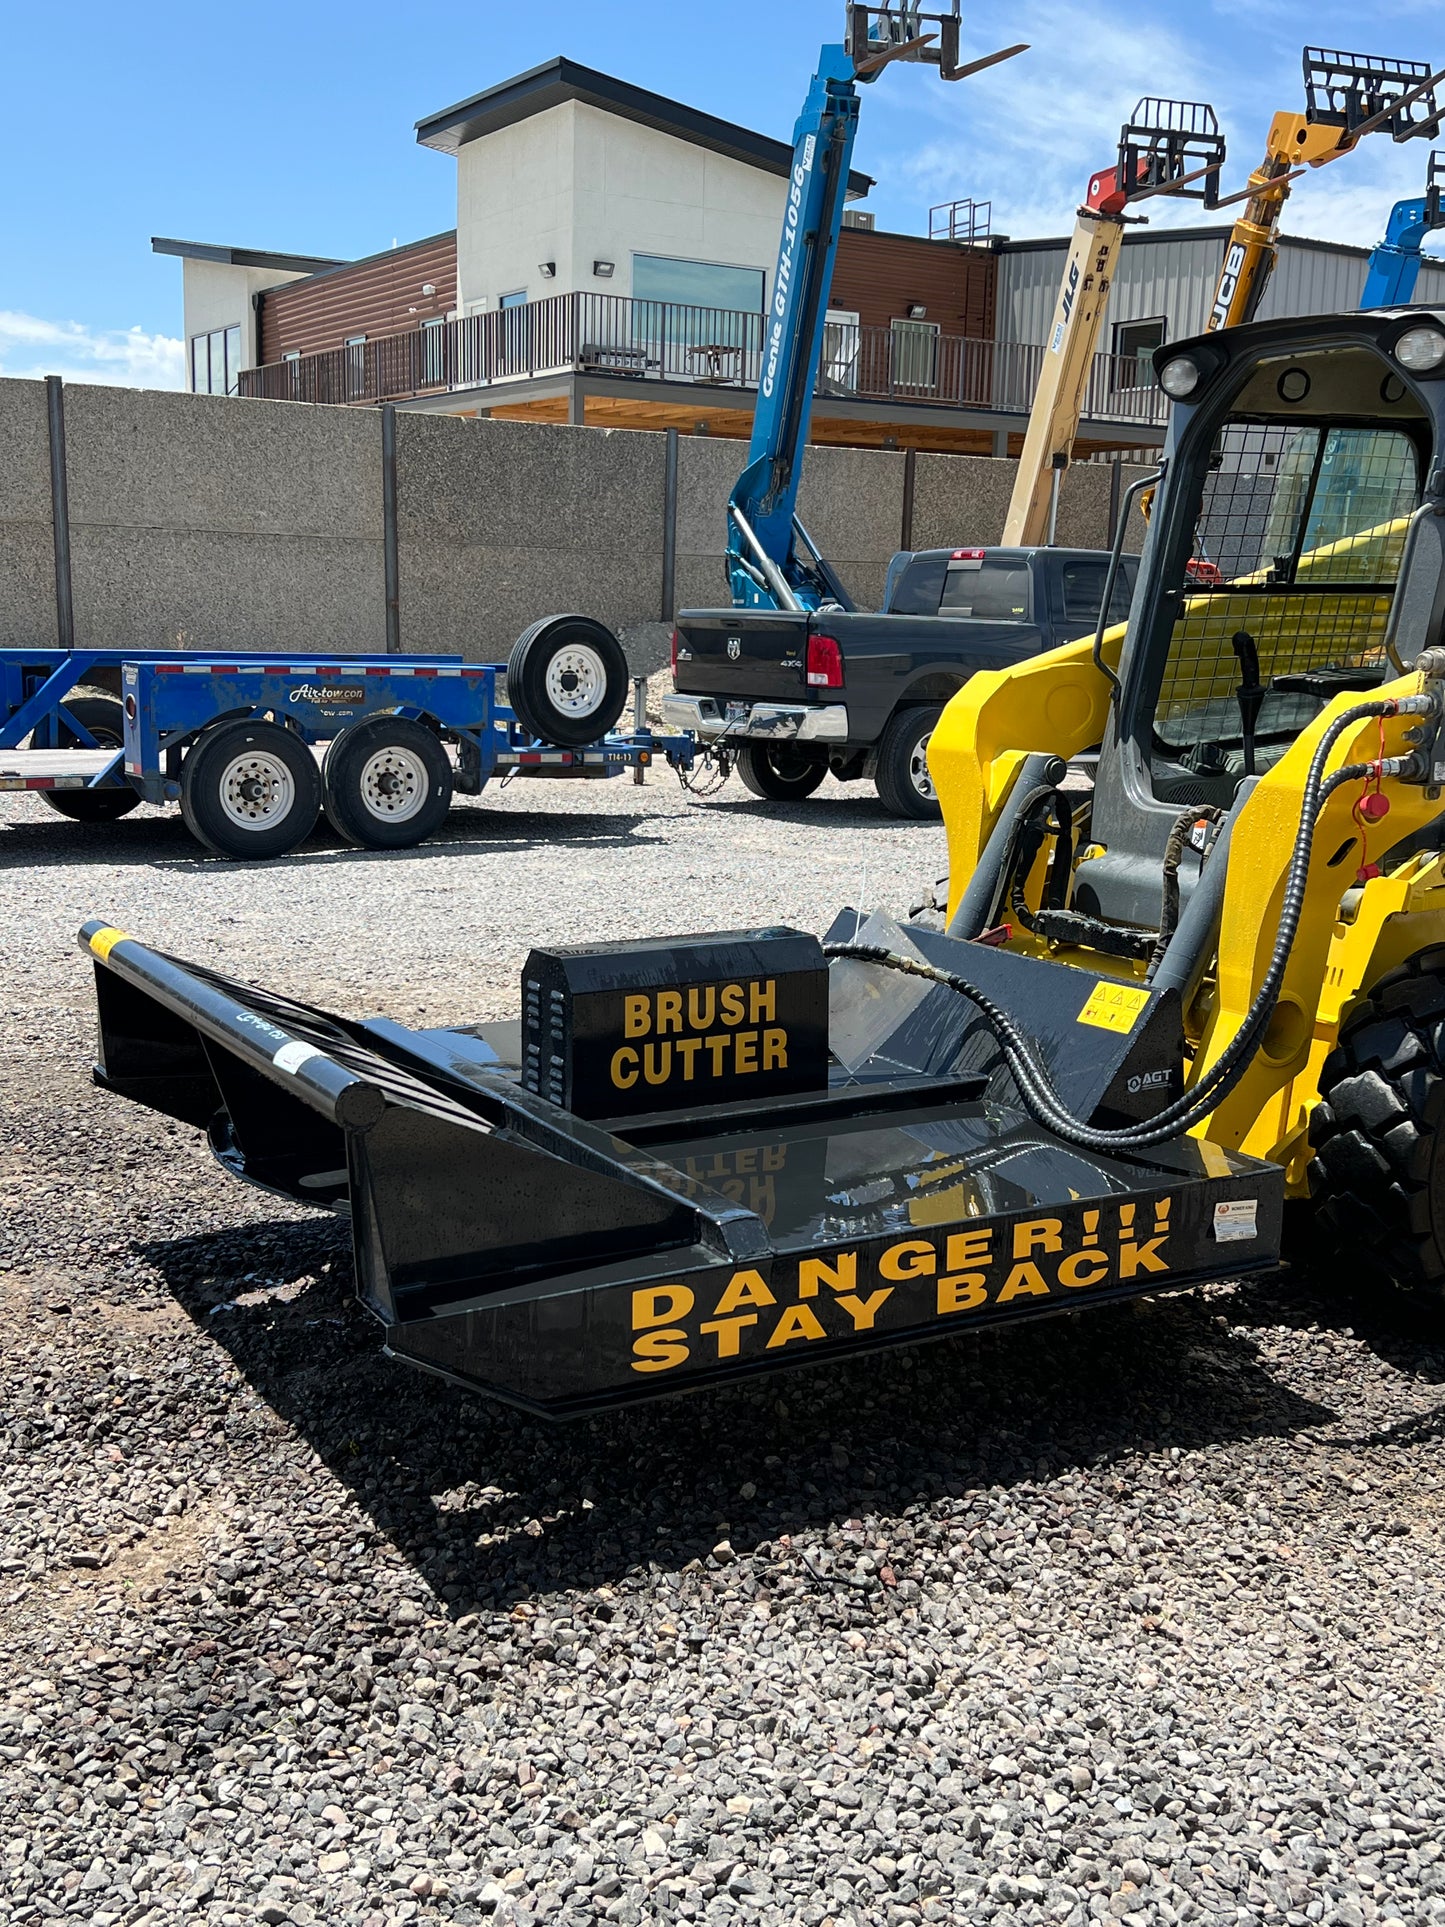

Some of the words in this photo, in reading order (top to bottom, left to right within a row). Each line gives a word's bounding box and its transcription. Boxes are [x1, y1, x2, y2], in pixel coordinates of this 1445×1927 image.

[762, 320, 783, 397] Genie
[775, 163, 805, 317] GTH-1056
[1062, 260, 1079, 324] JLG
[1213, 245, 1245, 330] JCB
[780, 659, 803, 668] 4X4
[624, 979, 776, 1039] BRUSH
[610, 1028, 788, 1090] CUTTER
[1142, 1069, 1173, 1085] AGT
[632, 1197, 1171, 1331] DANGER!!!
[630, 1287, 895, 1373] STAY
[937, 1236, 1170, 1315] BACK
